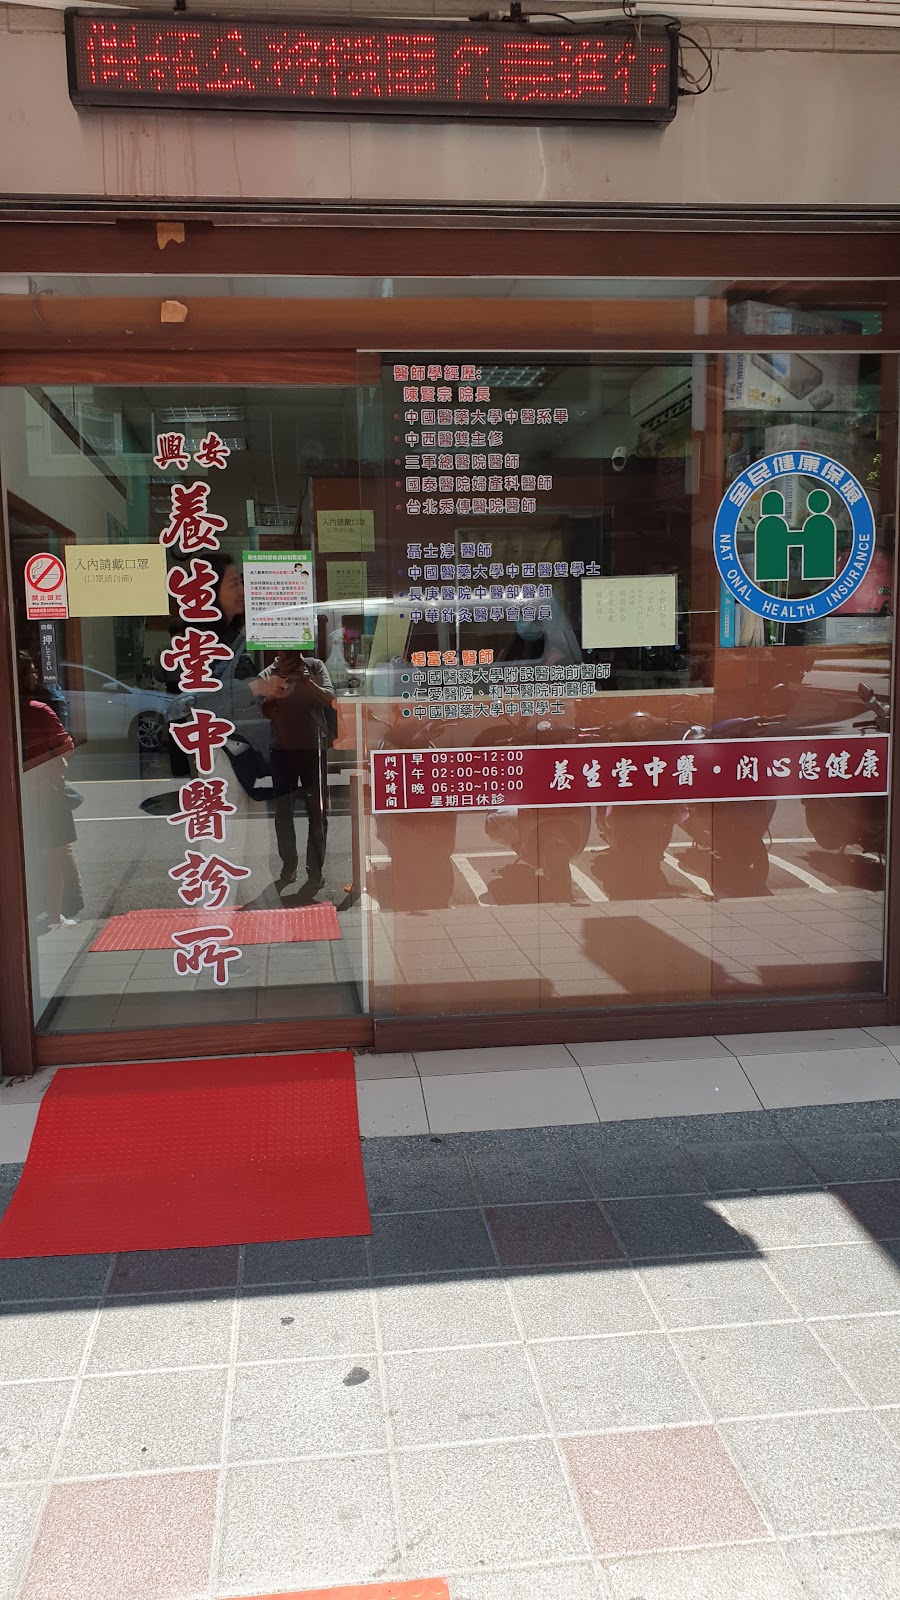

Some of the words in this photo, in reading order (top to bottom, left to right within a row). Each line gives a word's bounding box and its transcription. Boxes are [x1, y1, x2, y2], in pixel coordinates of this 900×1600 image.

[393, 365, 482, 381] 醫師學經歷:
[403, 387, 453, 402] 陳賢宗
[458, 387, 491, 402] 院長
[404, 408, 569, 425] 中國醫藥大學中醫系畢
[405, 430, 504, 447] 中西醫雙主修
[153, 431, 231, 469] 興安
[404, 453, 520, 470] 三軍總醫院醫師
[405, 475, 553, 493] 國泰醫院婦產科醫師
[729, 454, 863, 508] 全民健康保險
[406, 497, 537, 515] 台北秀傳醫院醫師
[407, 543, 455, 559] 聶士淳
[461, 543, 492, 558] 醫師
[75, 558, 150, 571] 入內請戴口罩
[408, 561, 601, 581] 中國醫藥大學中西醫雙學士
[720, 534, 751, 602] NATONAL
[761, 600, 815, 618] HEALTH
[826, 533, 870, 607] INSURANCE
[408, 585, 553, 602] 長庚醫院中醫部醫師
[409, 606, 552, 624] 中華針灸醫學會會員
[411, 651, 457, 667] 楊富名
[462, 649, 494, 665] 醫師
[412, 664, 611, 686] 中國醫藥大學附設醫院前醫師
[412, 682, 596, 703] 仁愛醫院、和平醫院前醫師
[413, 701, 565, 721] 中國醫藥大學中醫學士
[159, 481, 251, 987] 養生堂中醫診所
[410, 754, 425, 766] 早
[431, 751, 524, 764] 09:00~12:00
[383, 755, 399, 808] 門診時間
[410, 767, 425, 780] 午
[431, 765, 524, 779] 02:00~06:00
[411, 782, 426, 795] 晚
[431, 780, 524, 794] 06:30~10:00
[429, 794, 505, 807] 星期日休診
